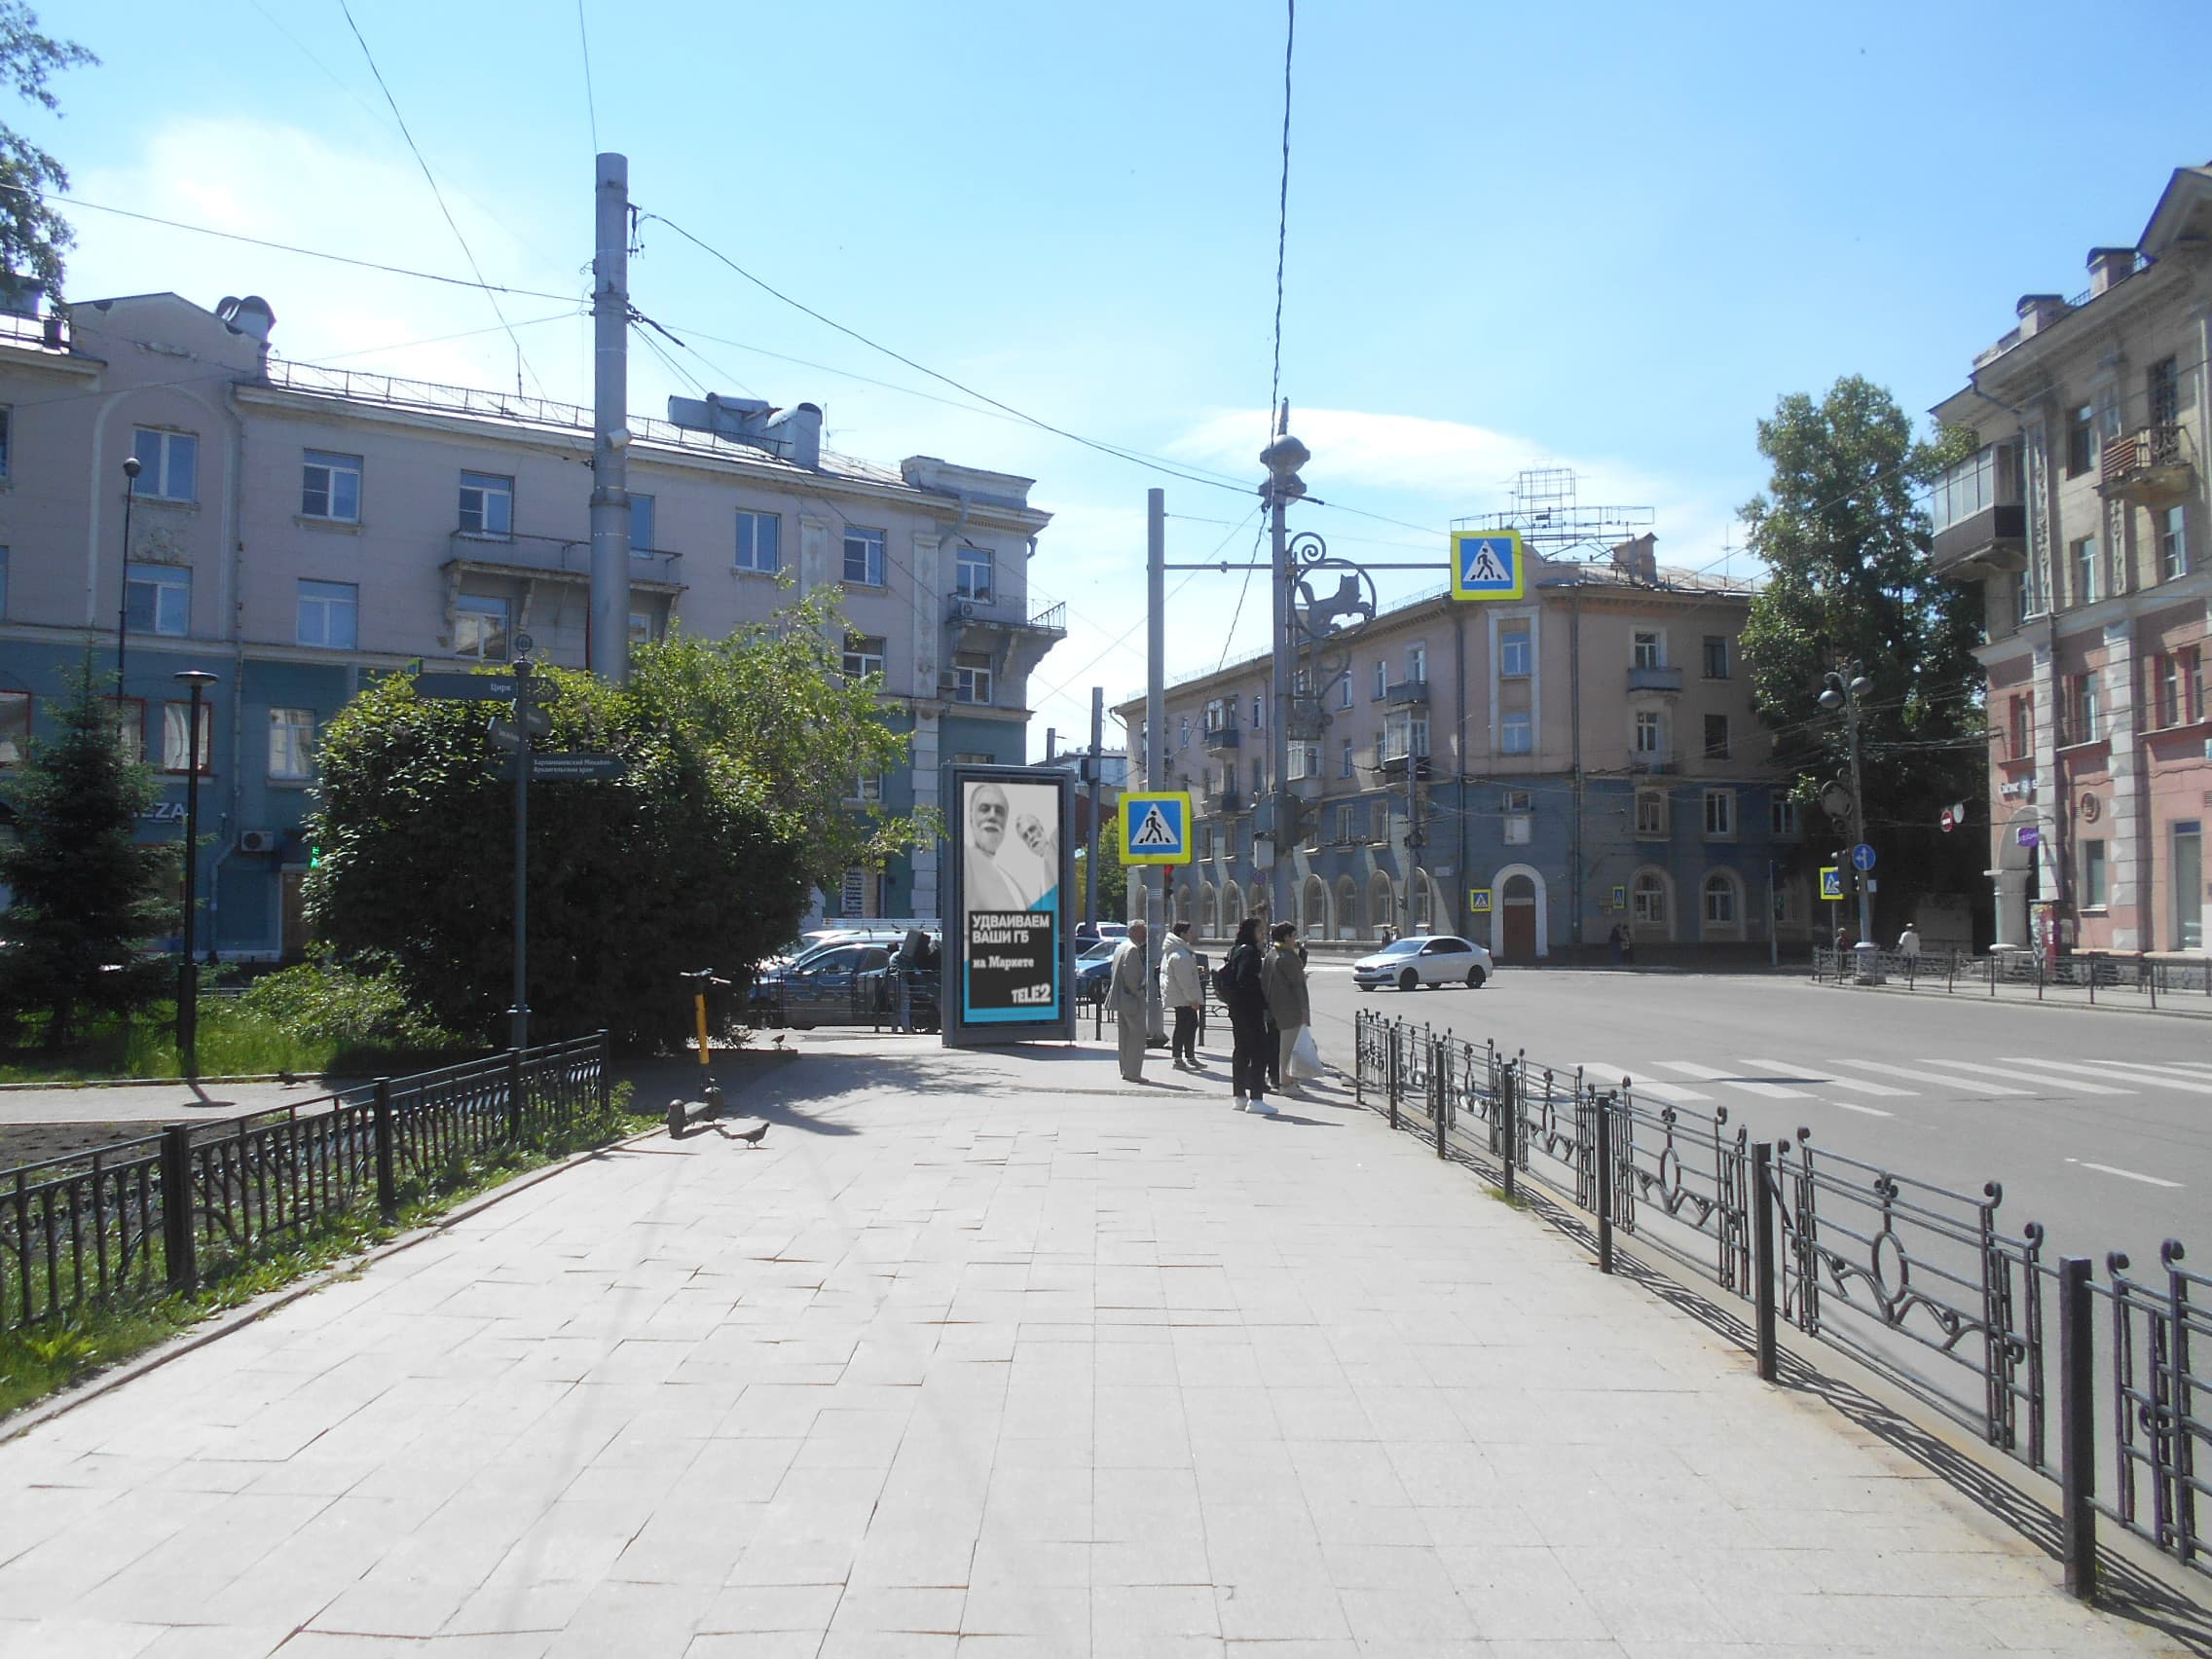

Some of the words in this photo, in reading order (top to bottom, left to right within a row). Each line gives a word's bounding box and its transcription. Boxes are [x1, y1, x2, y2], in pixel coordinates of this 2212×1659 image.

[491, 682, 512, 693] Цирк
[972, 915, 1050, 930] УДВАИВАЕМ
[972, 930, 1011, 943] ВАШИ
[1014, 930, 1029, 943] ГБ
[973, 958, 986, 969] на
[988, 956, 1034, 971] Маркете
[1012, 983, 1051, 1004] TELE2
